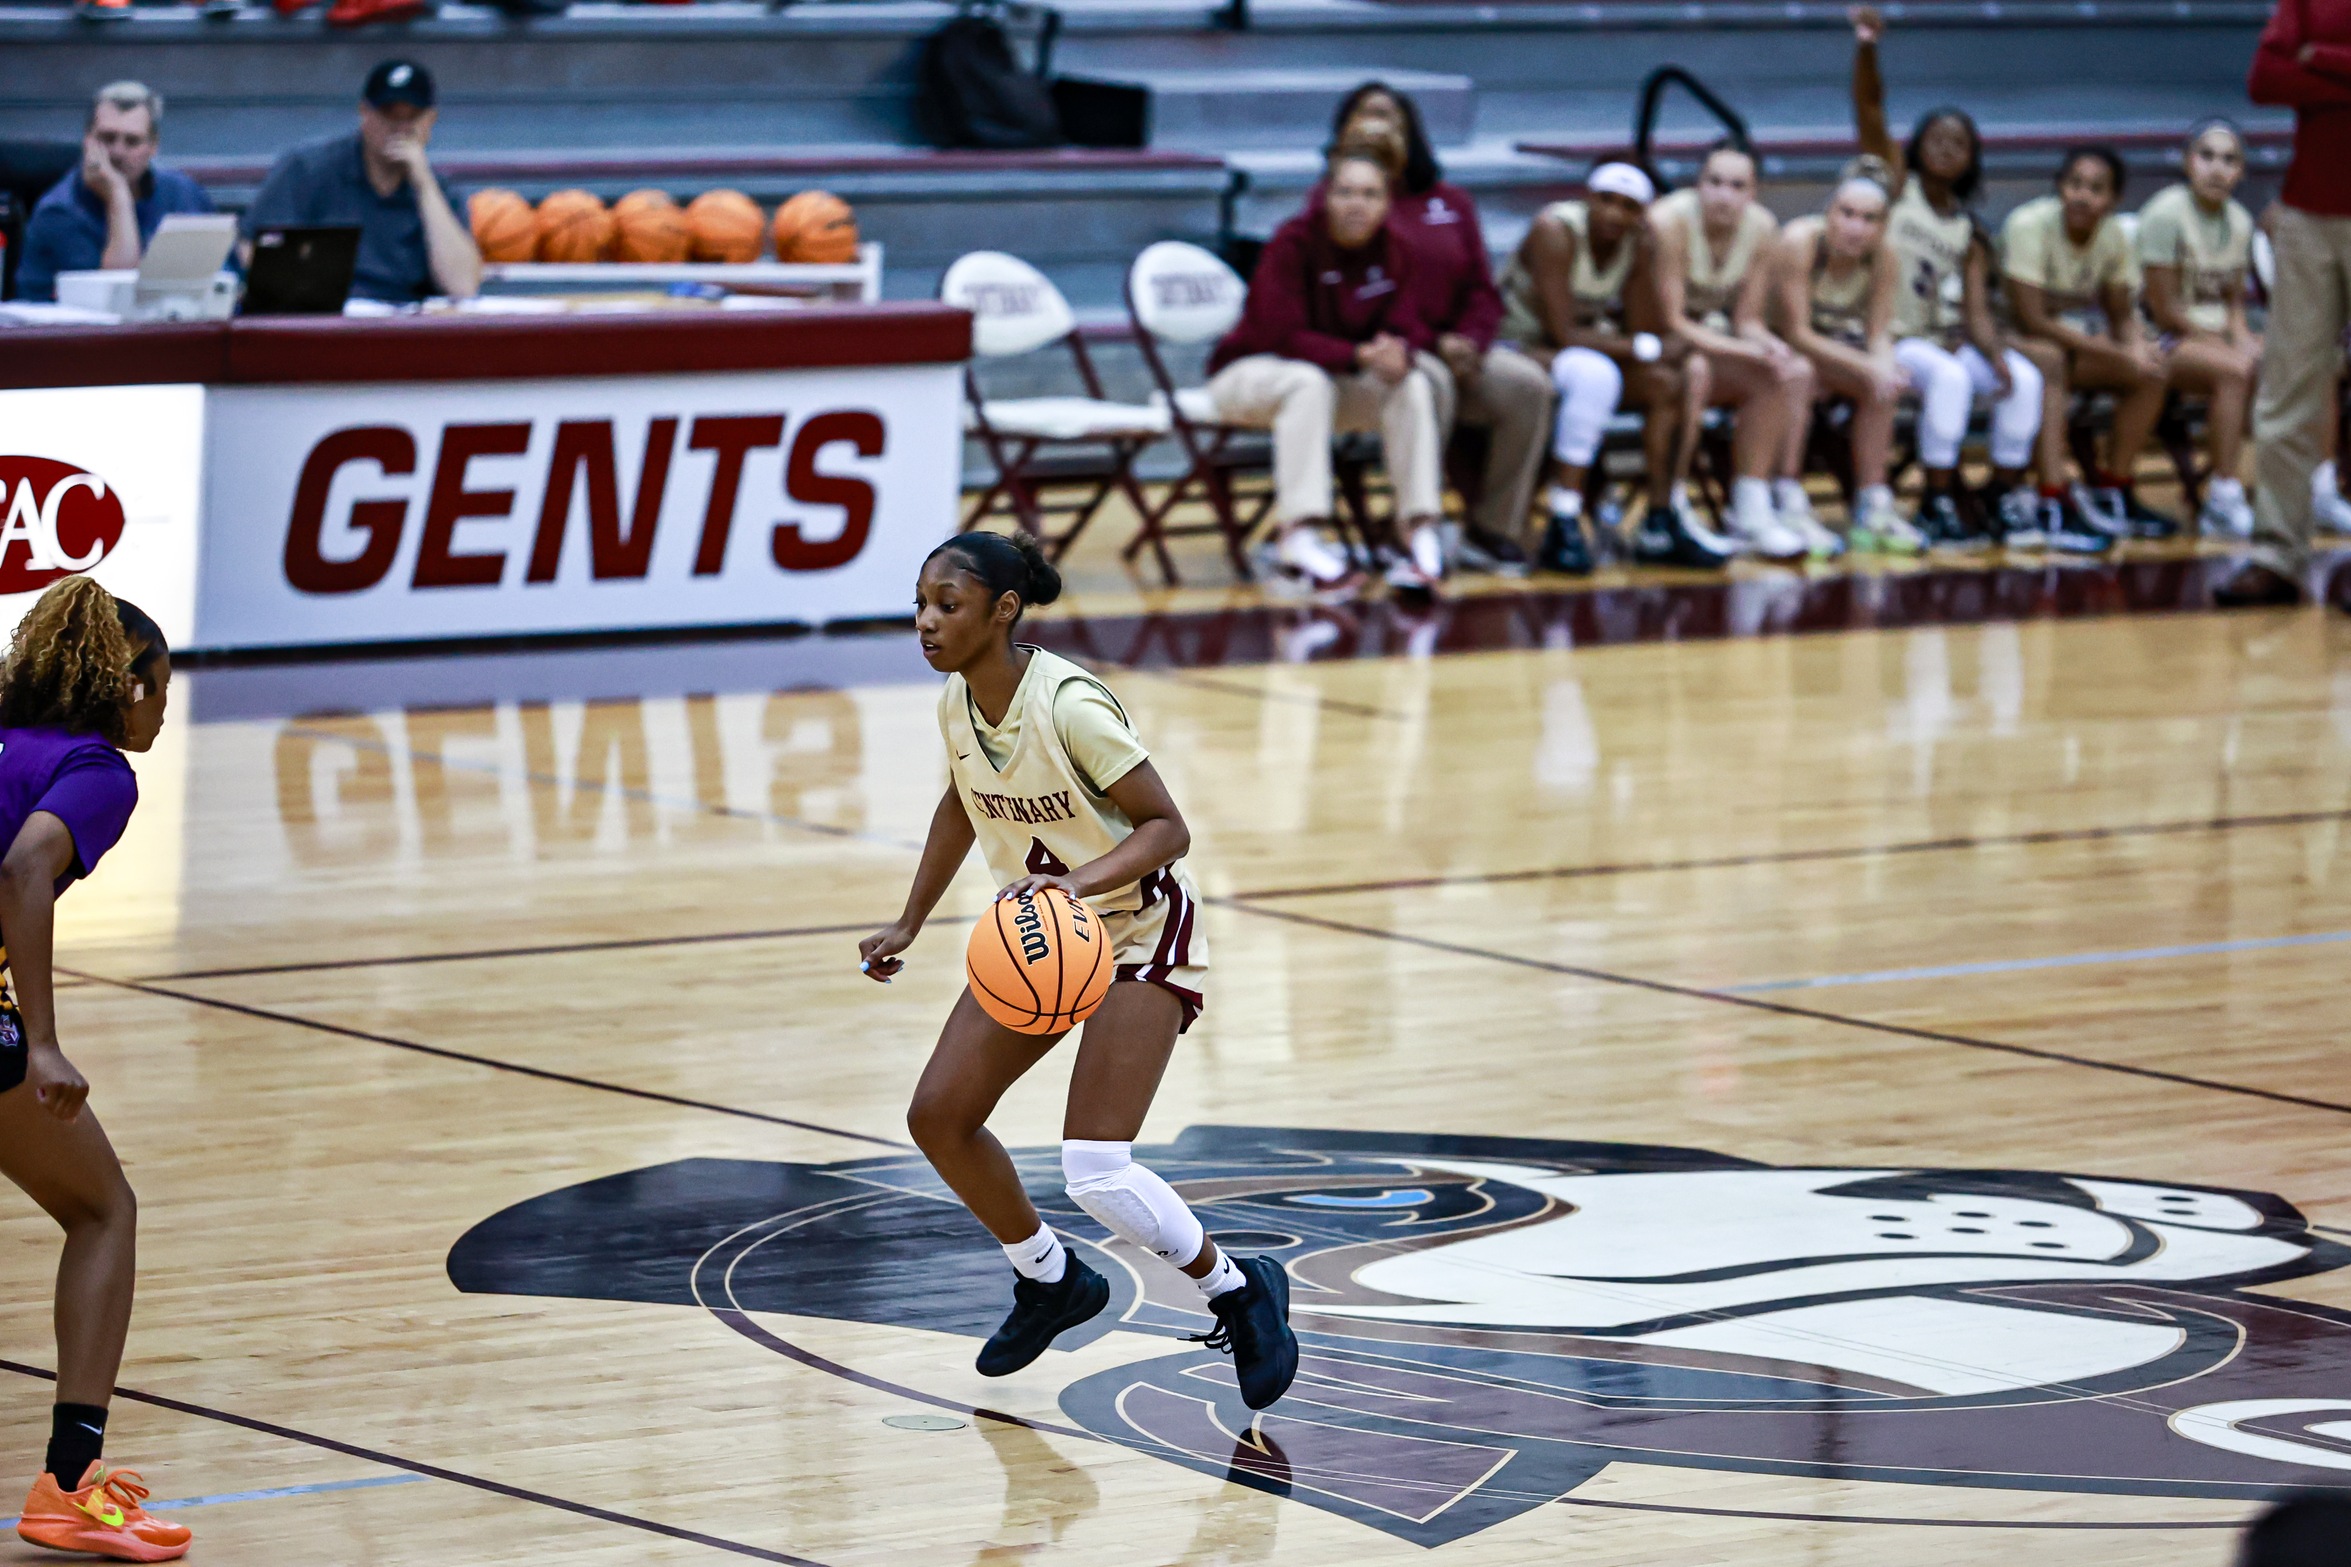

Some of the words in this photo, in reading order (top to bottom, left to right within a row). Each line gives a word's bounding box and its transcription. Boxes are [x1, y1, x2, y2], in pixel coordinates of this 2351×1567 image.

[0, 472, 106, 571] AC
[284, 407, 887, 596] GENTS
[1023, 834, 1071, 877] 4
[1014, 892, 1050, 966] Wilso
